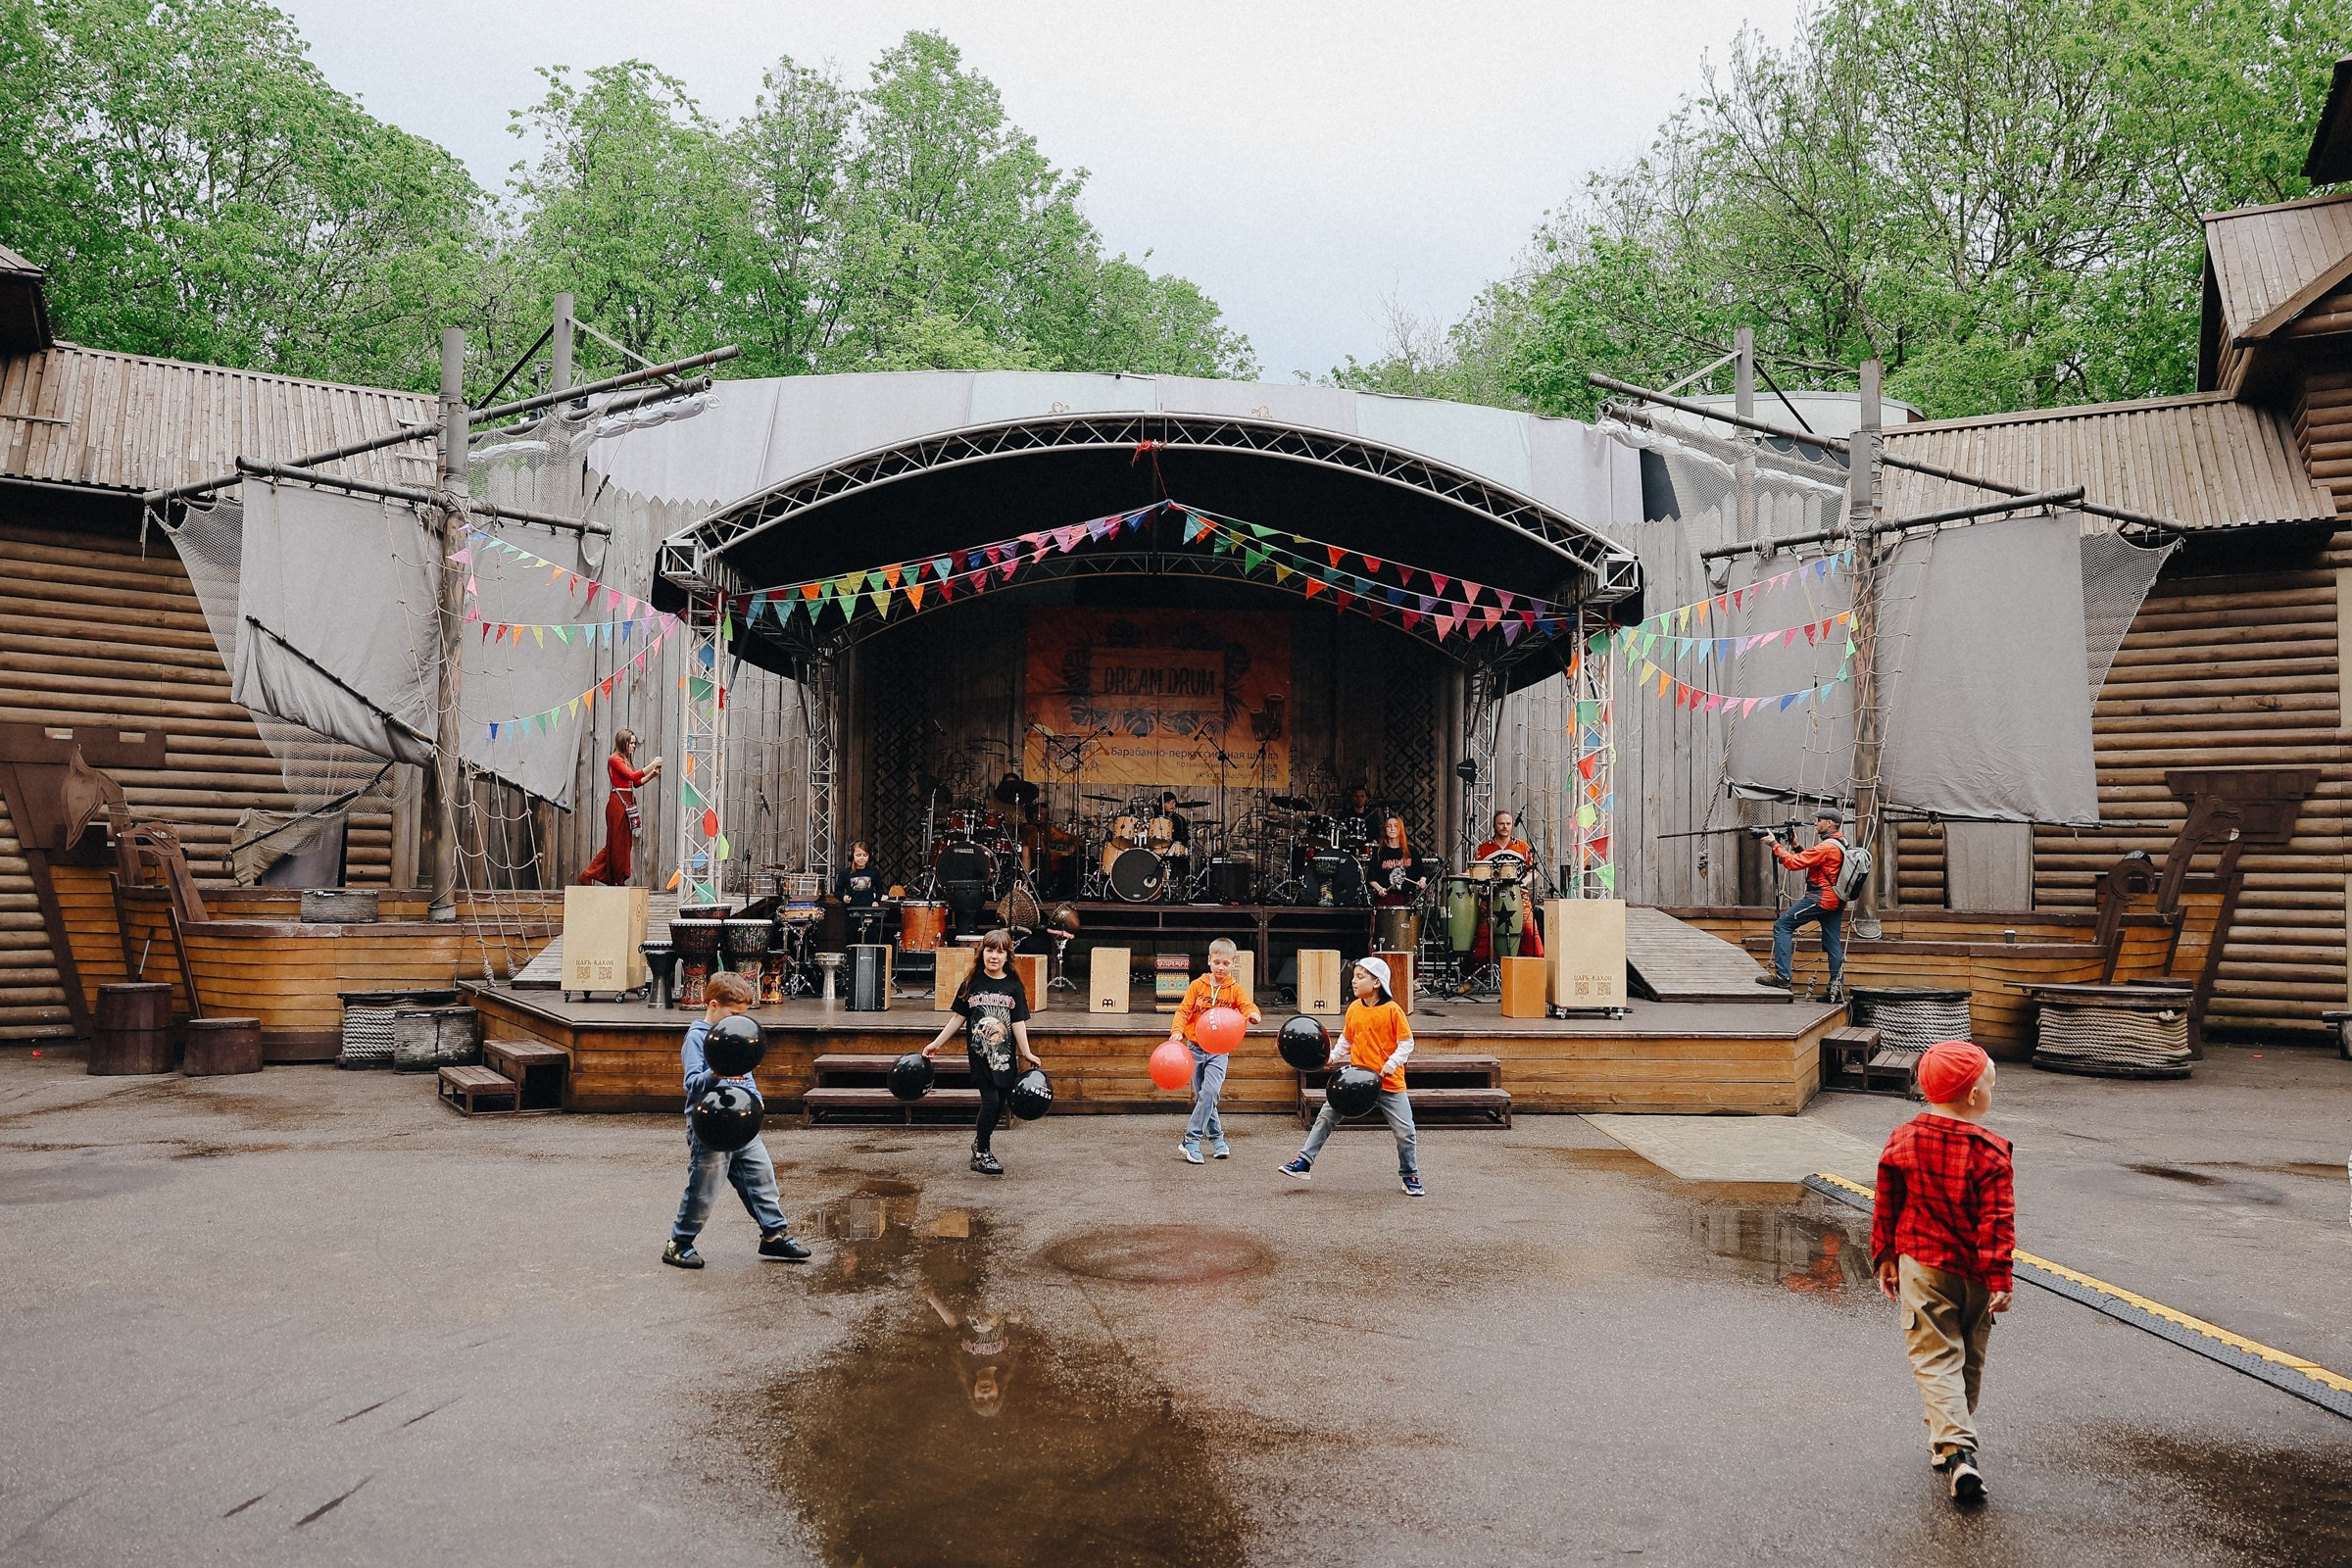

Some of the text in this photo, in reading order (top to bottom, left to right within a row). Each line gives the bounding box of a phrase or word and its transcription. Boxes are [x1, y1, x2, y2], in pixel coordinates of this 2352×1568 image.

[1104, 666, 1215, 695] DREAM DRUM
[1110, 746, 1245, 760] Барабанно-перкуссионая
